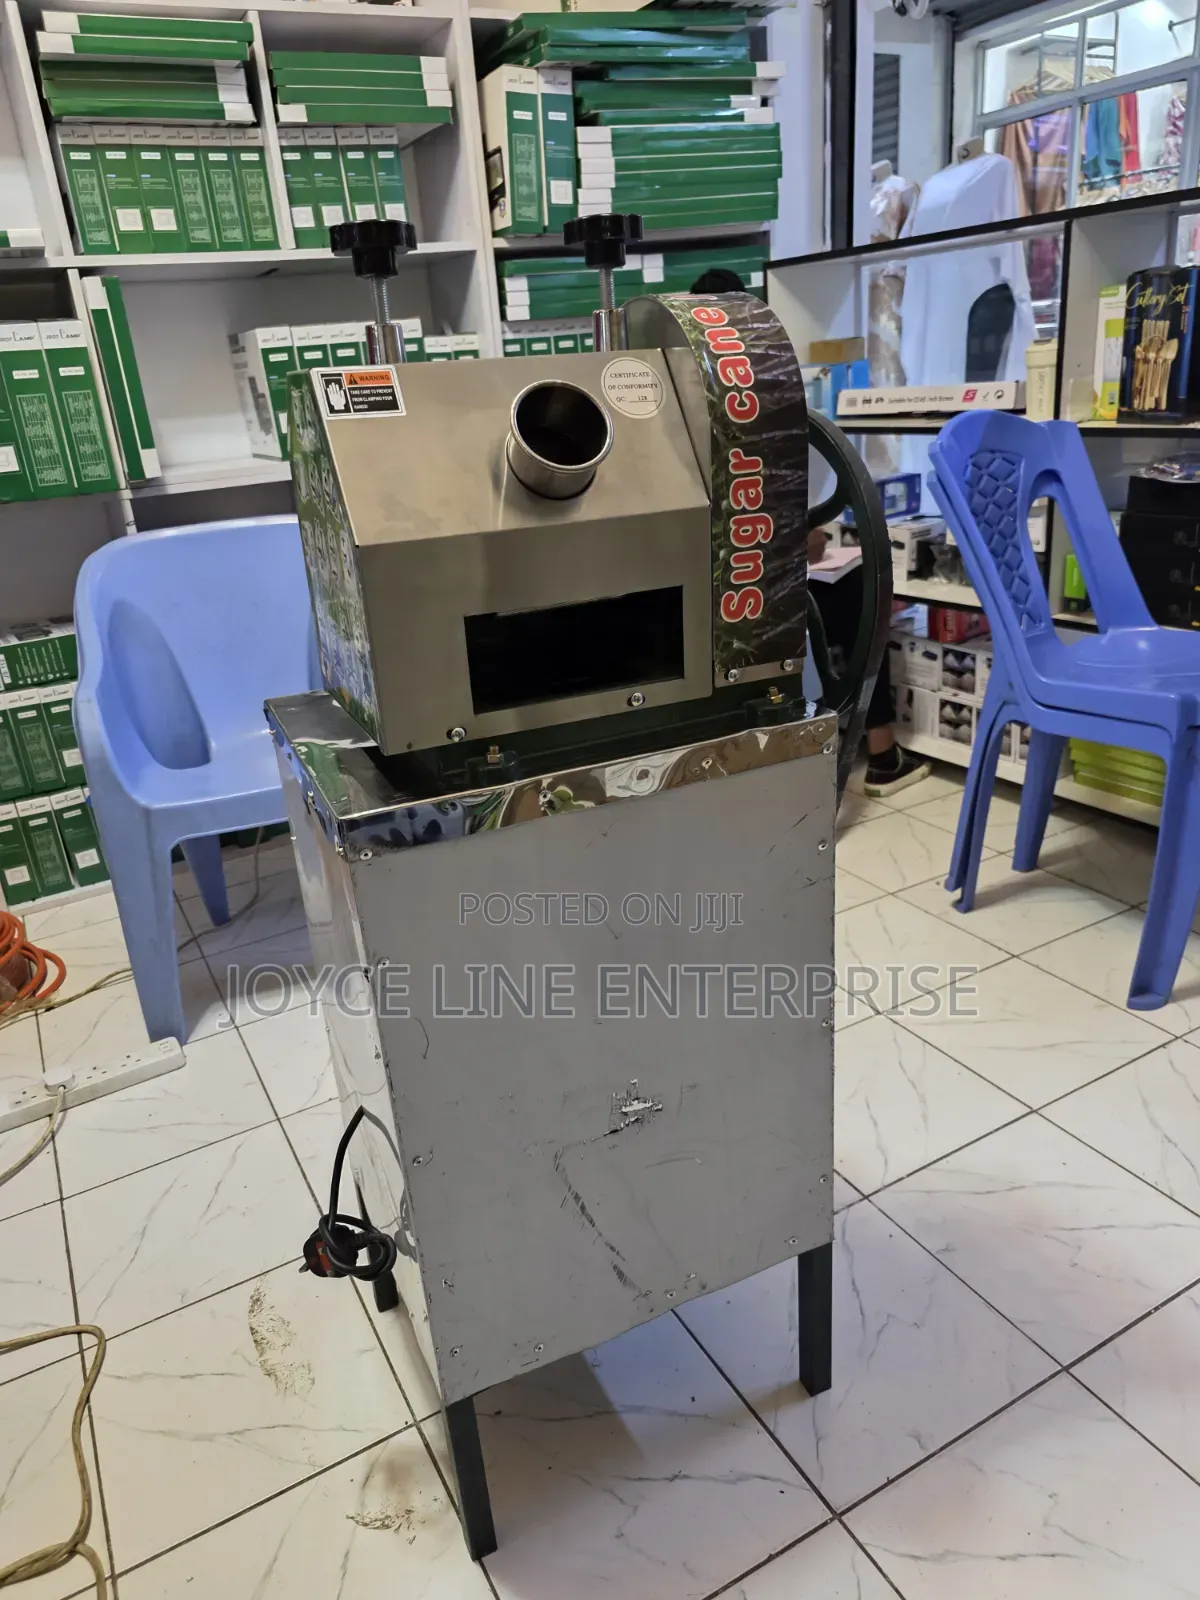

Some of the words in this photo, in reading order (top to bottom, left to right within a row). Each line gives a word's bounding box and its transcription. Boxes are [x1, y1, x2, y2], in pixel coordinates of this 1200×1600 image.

[610, 371, 650, 379] CERTIFICATE
[691, 305, 759, 424] cane
[721, 447, 773, 622] Sugar
